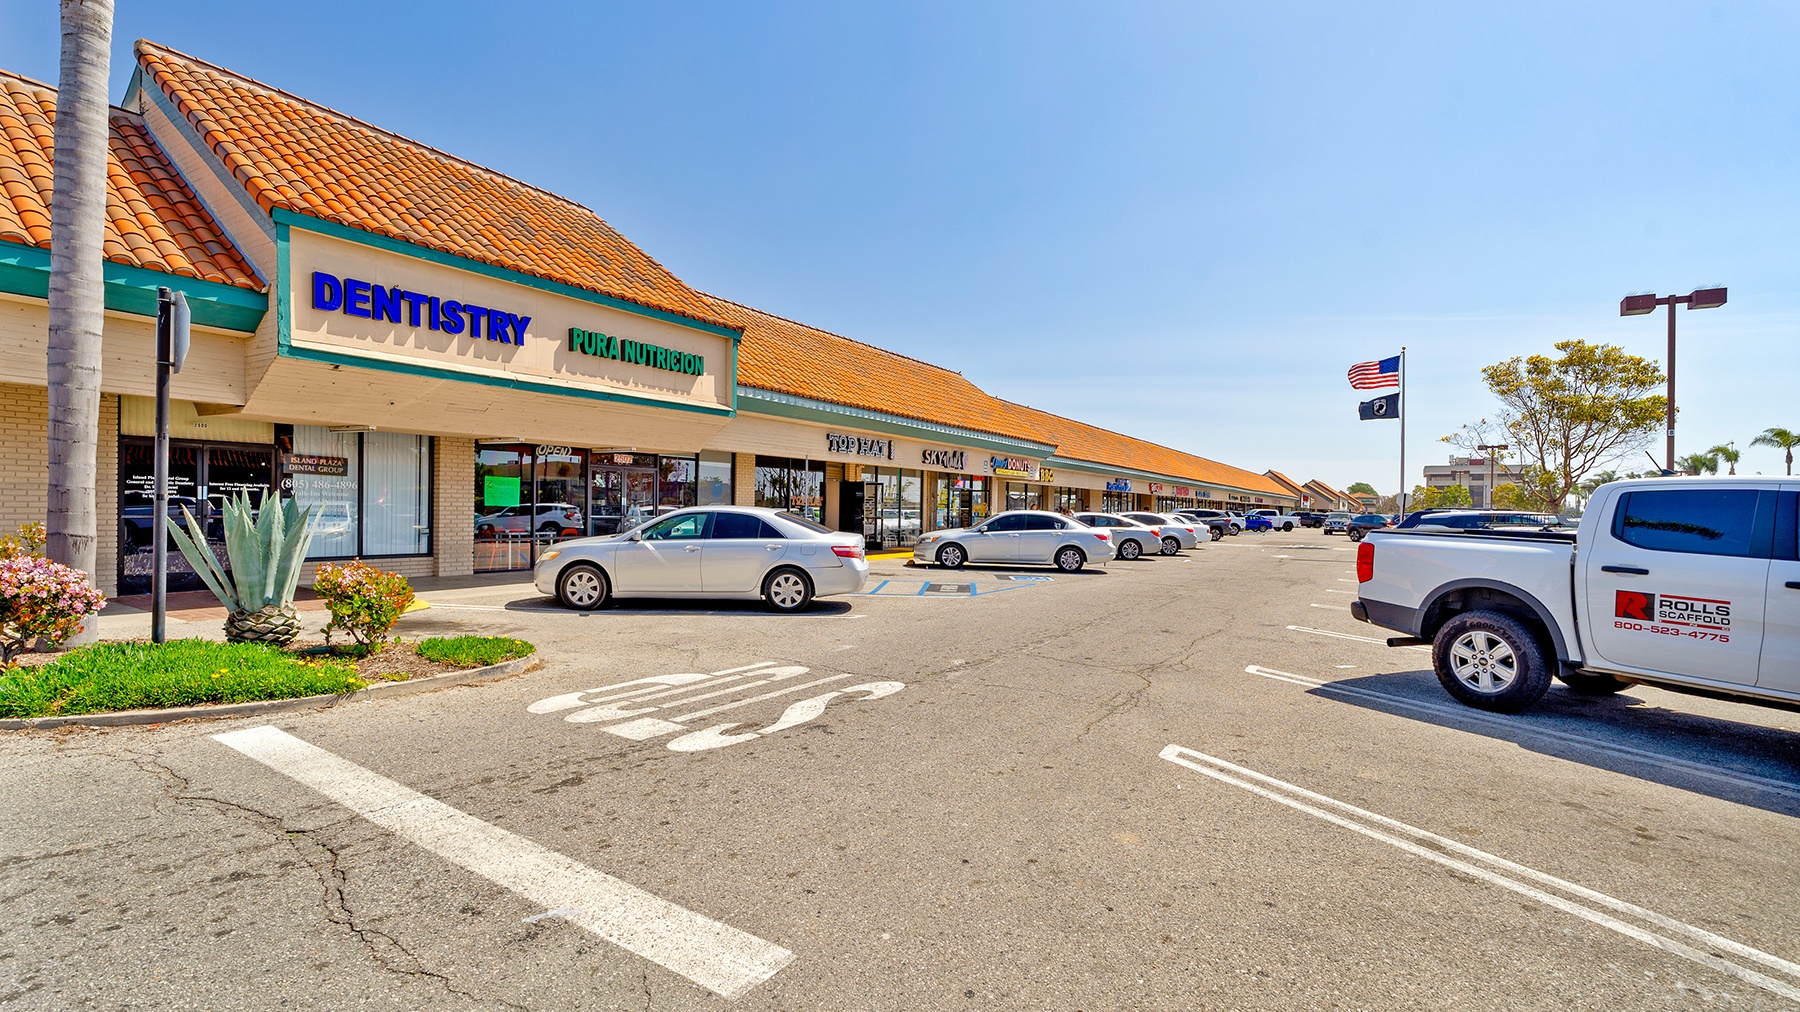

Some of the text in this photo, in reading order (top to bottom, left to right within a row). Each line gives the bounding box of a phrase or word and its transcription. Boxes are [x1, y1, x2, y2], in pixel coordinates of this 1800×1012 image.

[312, 271, 532, 346] DENTISTRY
[569, 327, 704, 376] PURA NUTRICION
[537, 445, 570, 456] OPEN
[827, 433, 887, 457] TOP HAT
[291, 457, 342, 467] ISLAND PLAZA
[614, 454, 633, 463] 2502
[922, 449, 944, 465] SKY
[1008, 458, 1031, 472] DONUTS
[289, 464, 344, 474] DENTAL GROUP
[281, 478, 358, 490] (805) 486-4896
[1659, 599, 1730, 617] ROLLS
[1659, 610, 1730, 626] SCAFFOLD
[1614, 620, 1730, 643] 800-523-4775
[526, 661, 906, 752] STOP
